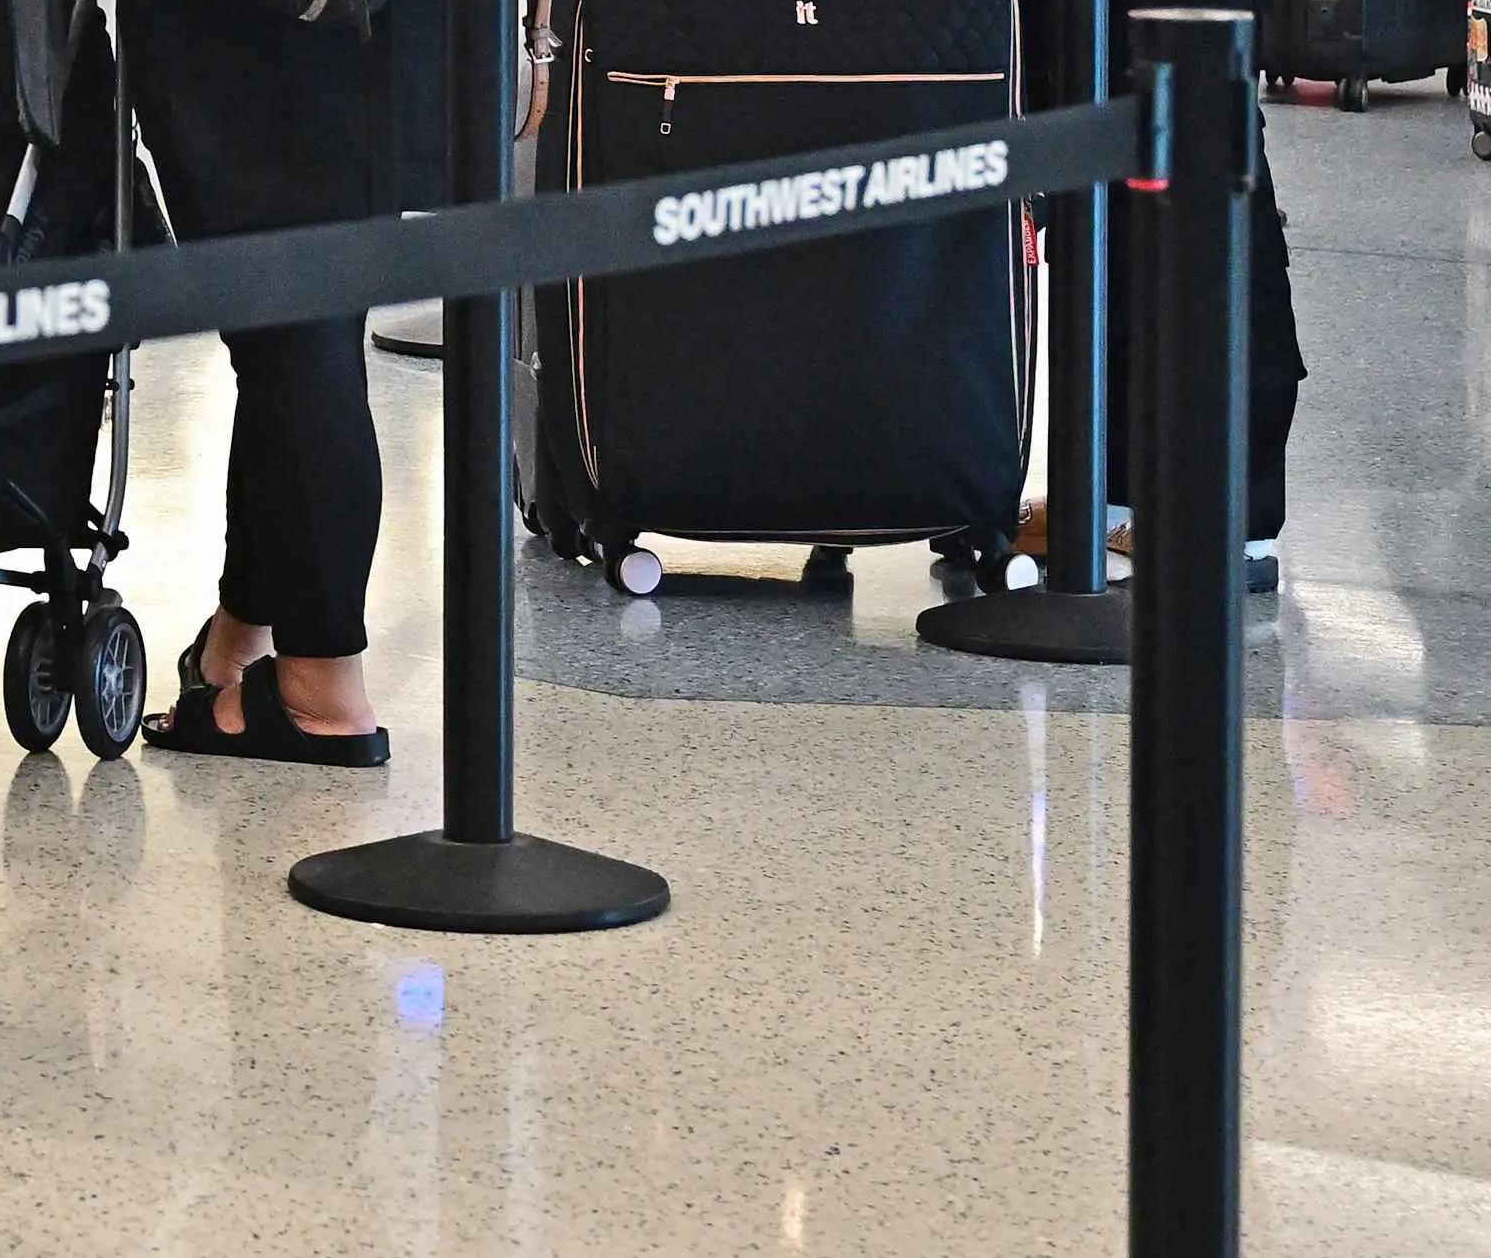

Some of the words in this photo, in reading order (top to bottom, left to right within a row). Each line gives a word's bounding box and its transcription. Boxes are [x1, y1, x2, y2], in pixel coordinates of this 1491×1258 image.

[795, 0, 819, 25] it
[653, 164, 867, 246] SOUTHWEST
[865, 140, 1009, 206] AIRLINES
